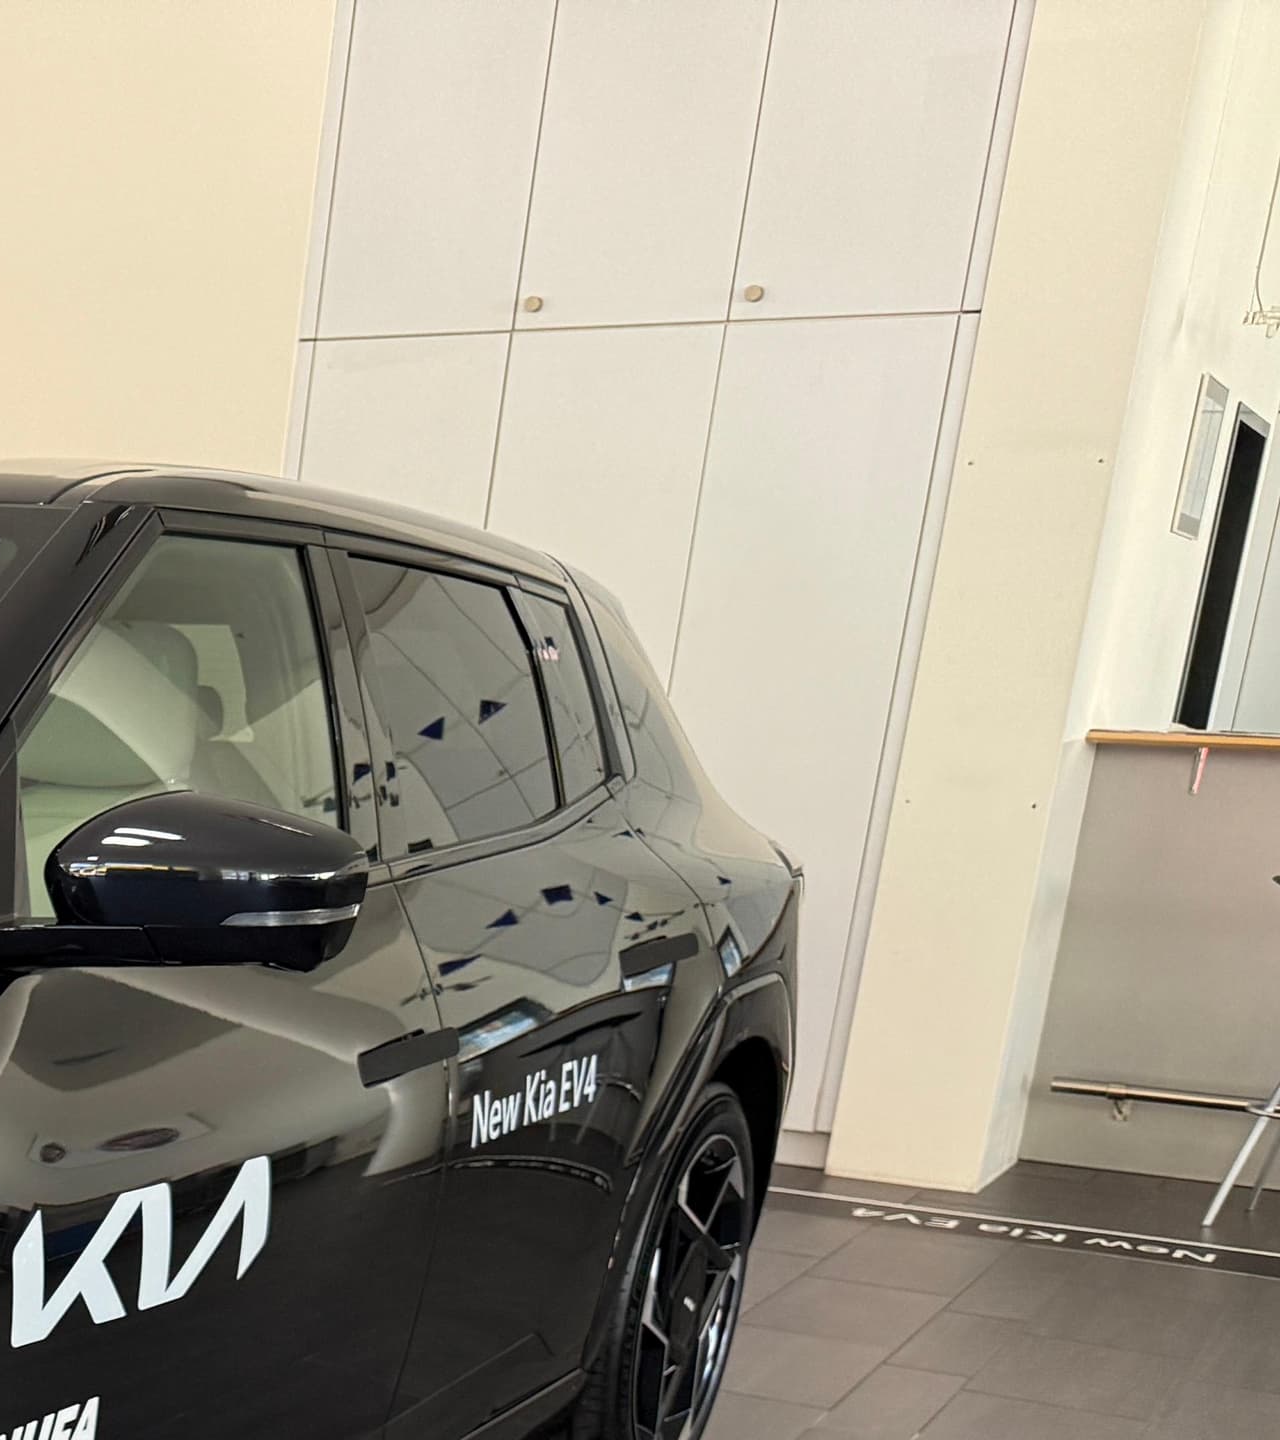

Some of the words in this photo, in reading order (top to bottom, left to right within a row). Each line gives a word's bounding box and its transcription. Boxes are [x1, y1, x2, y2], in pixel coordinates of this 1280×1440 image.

[471, 1089, 522, 1149] New
[523, 1069, 557, 1127] Kia
[559, 1054, 598, 1113] EV4
[11, 1155, 271, 1349] KIA
